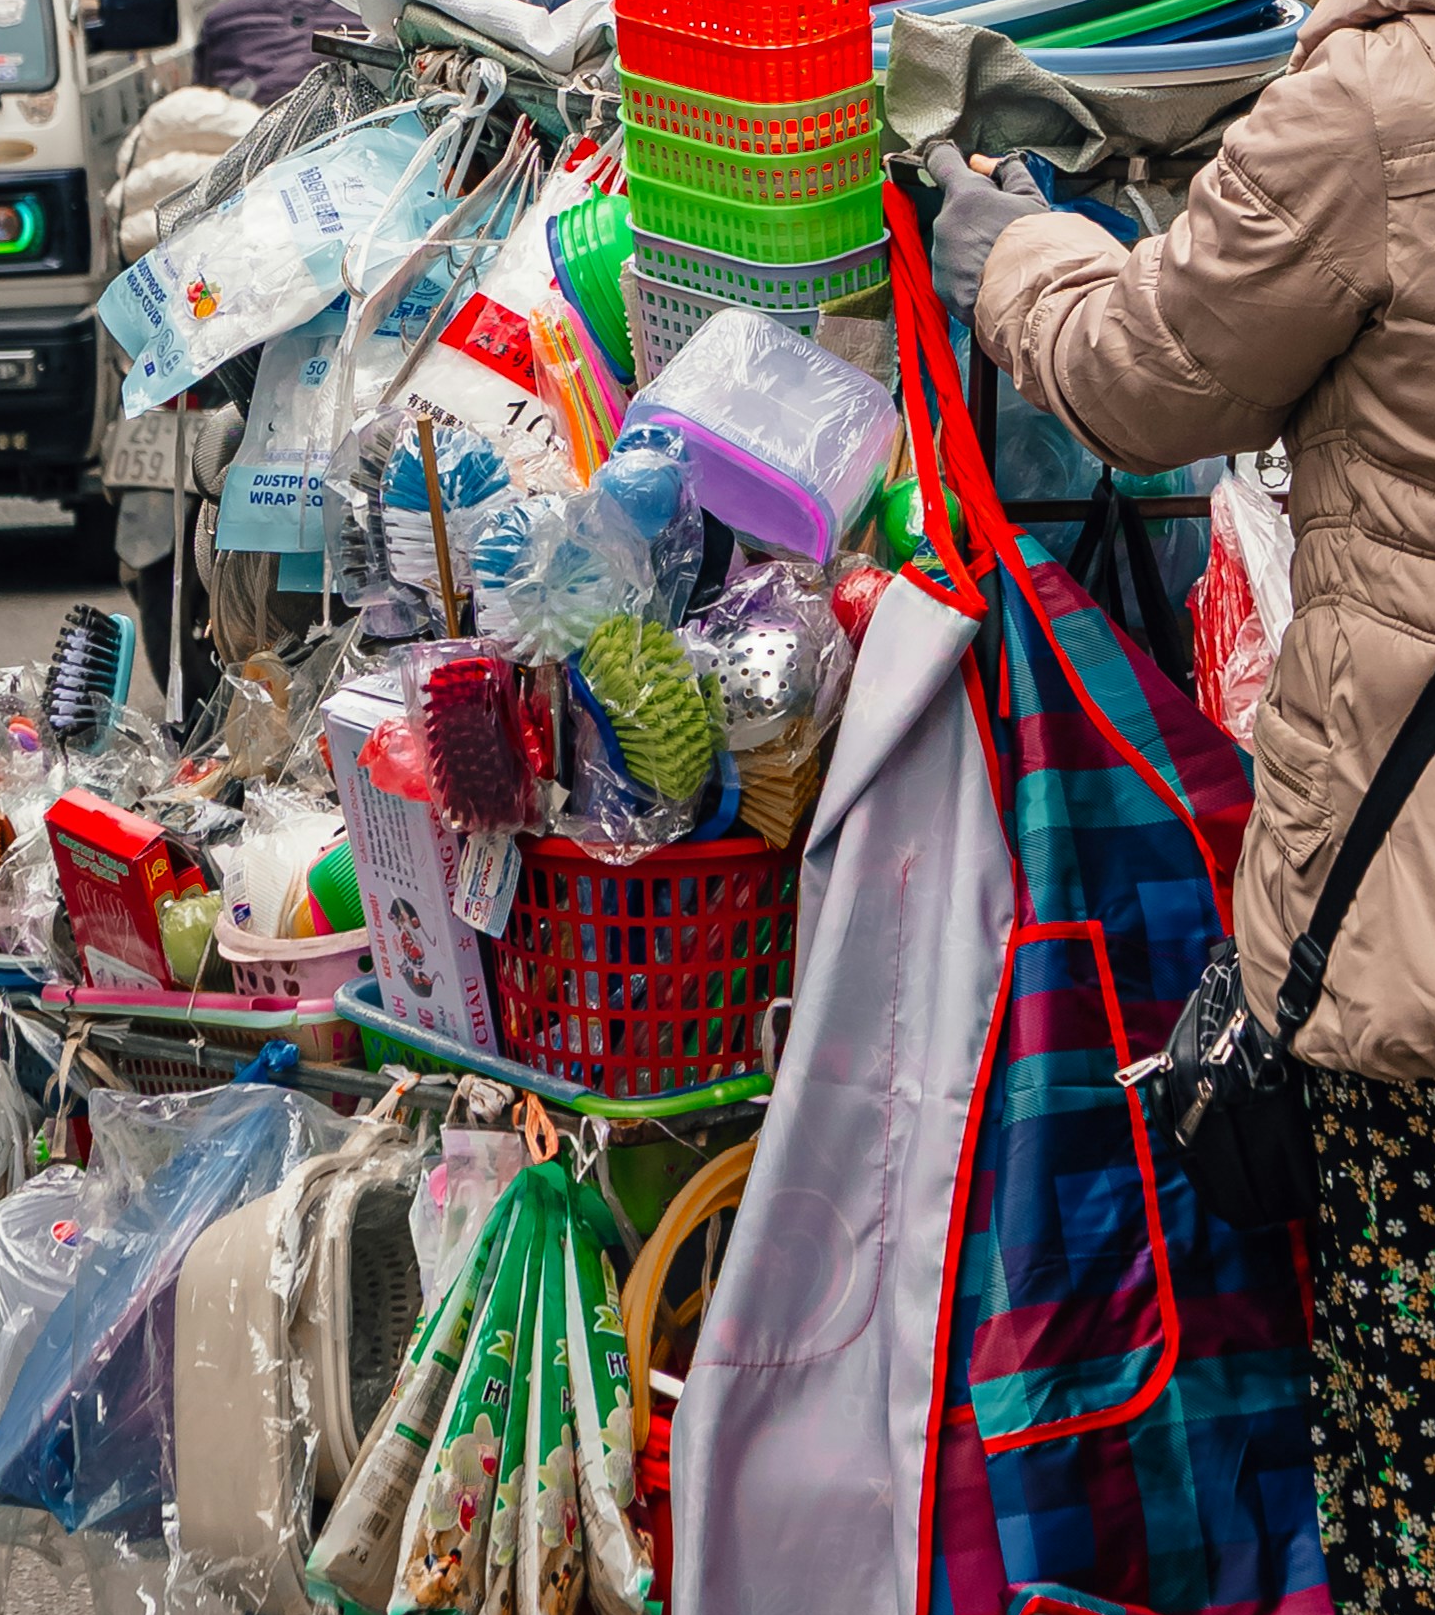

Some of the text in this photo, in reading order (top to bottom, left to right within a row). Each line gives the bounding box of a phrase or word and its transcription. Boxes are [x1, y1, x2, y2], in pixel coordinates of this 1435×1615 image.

[126, 269, 163, 329] WRAP COVER
[136, 257, 168, 304] DUSTPROOF
[305, 360, 328, 376] 50
[249, 491, 297, 507] WRAP
[463, 975, 489, 1046] CHÂU
